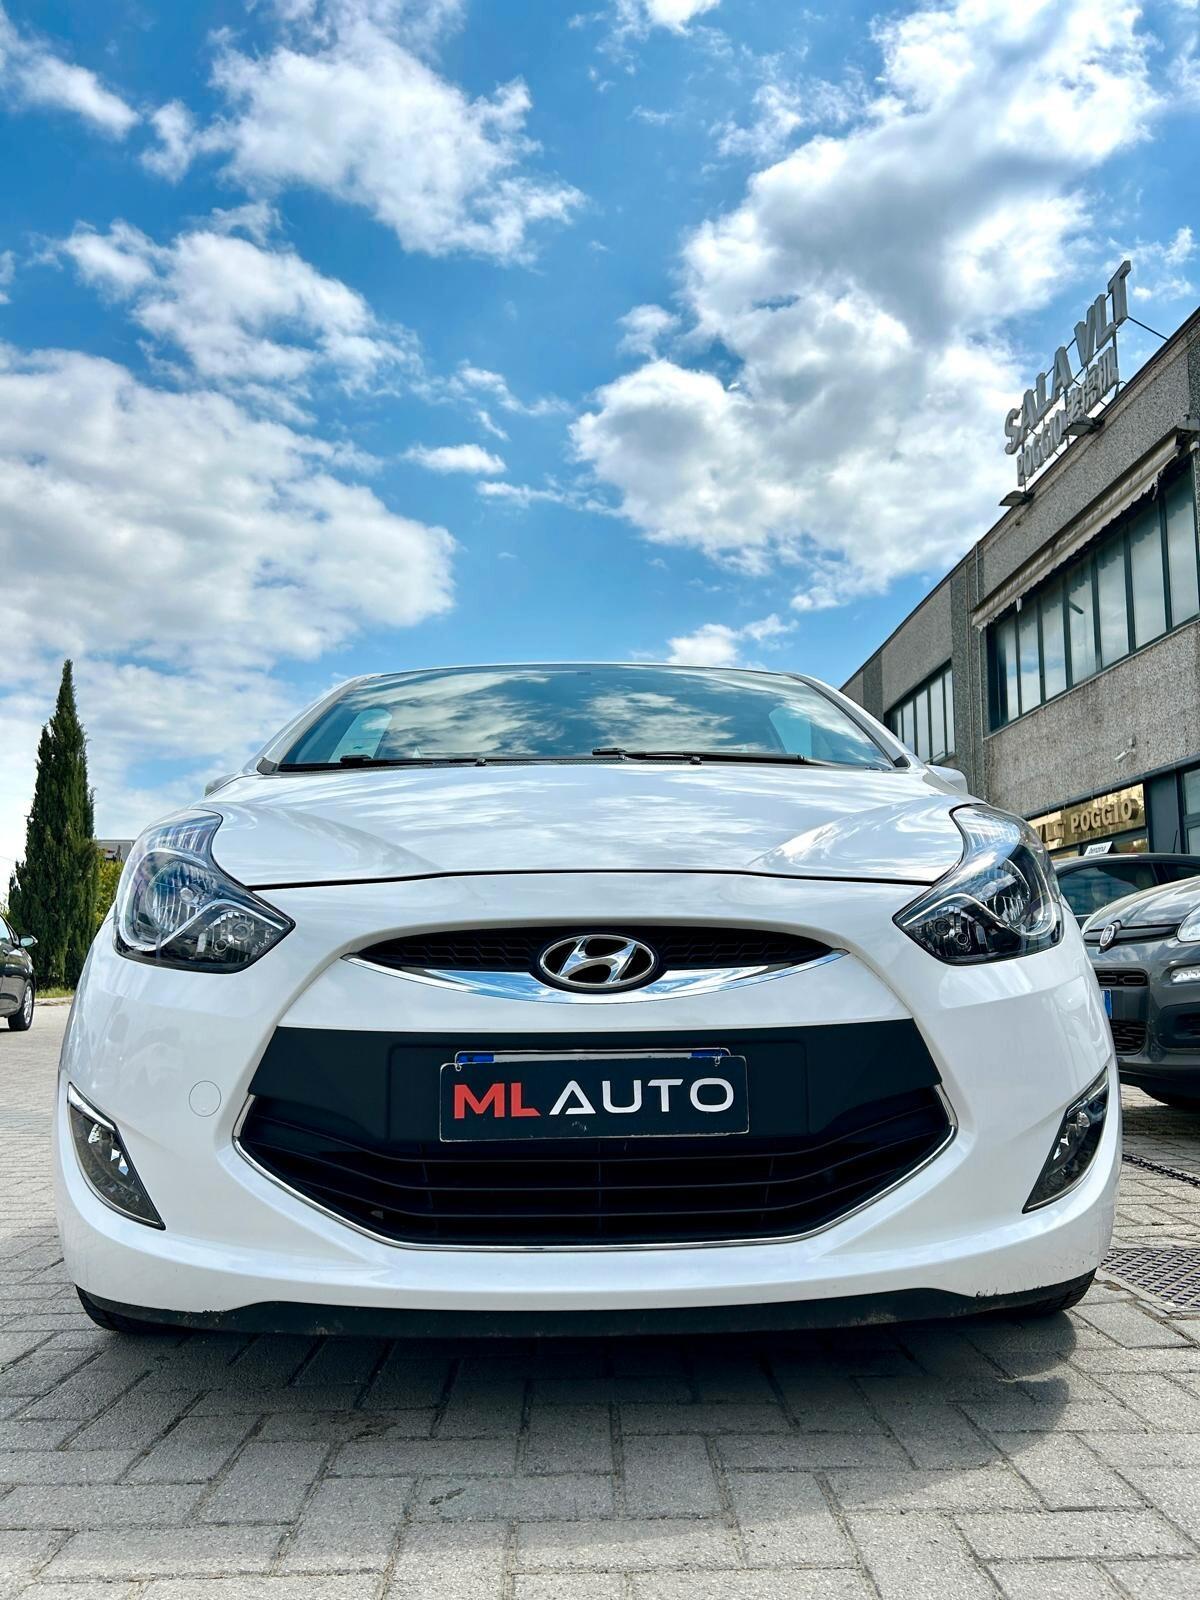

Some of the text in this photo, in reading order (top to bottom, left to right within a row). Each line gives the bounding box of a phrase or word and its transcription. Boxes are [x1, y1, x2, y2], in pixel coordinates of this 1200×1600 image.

[1005, 260, 1131, 455] SALA VLT
[1017, 410, 1068, 487] POGGIO
[1070, 798, 1132, 833] POGGIO
[454, 1078, 734, 1119] ML AUTO
